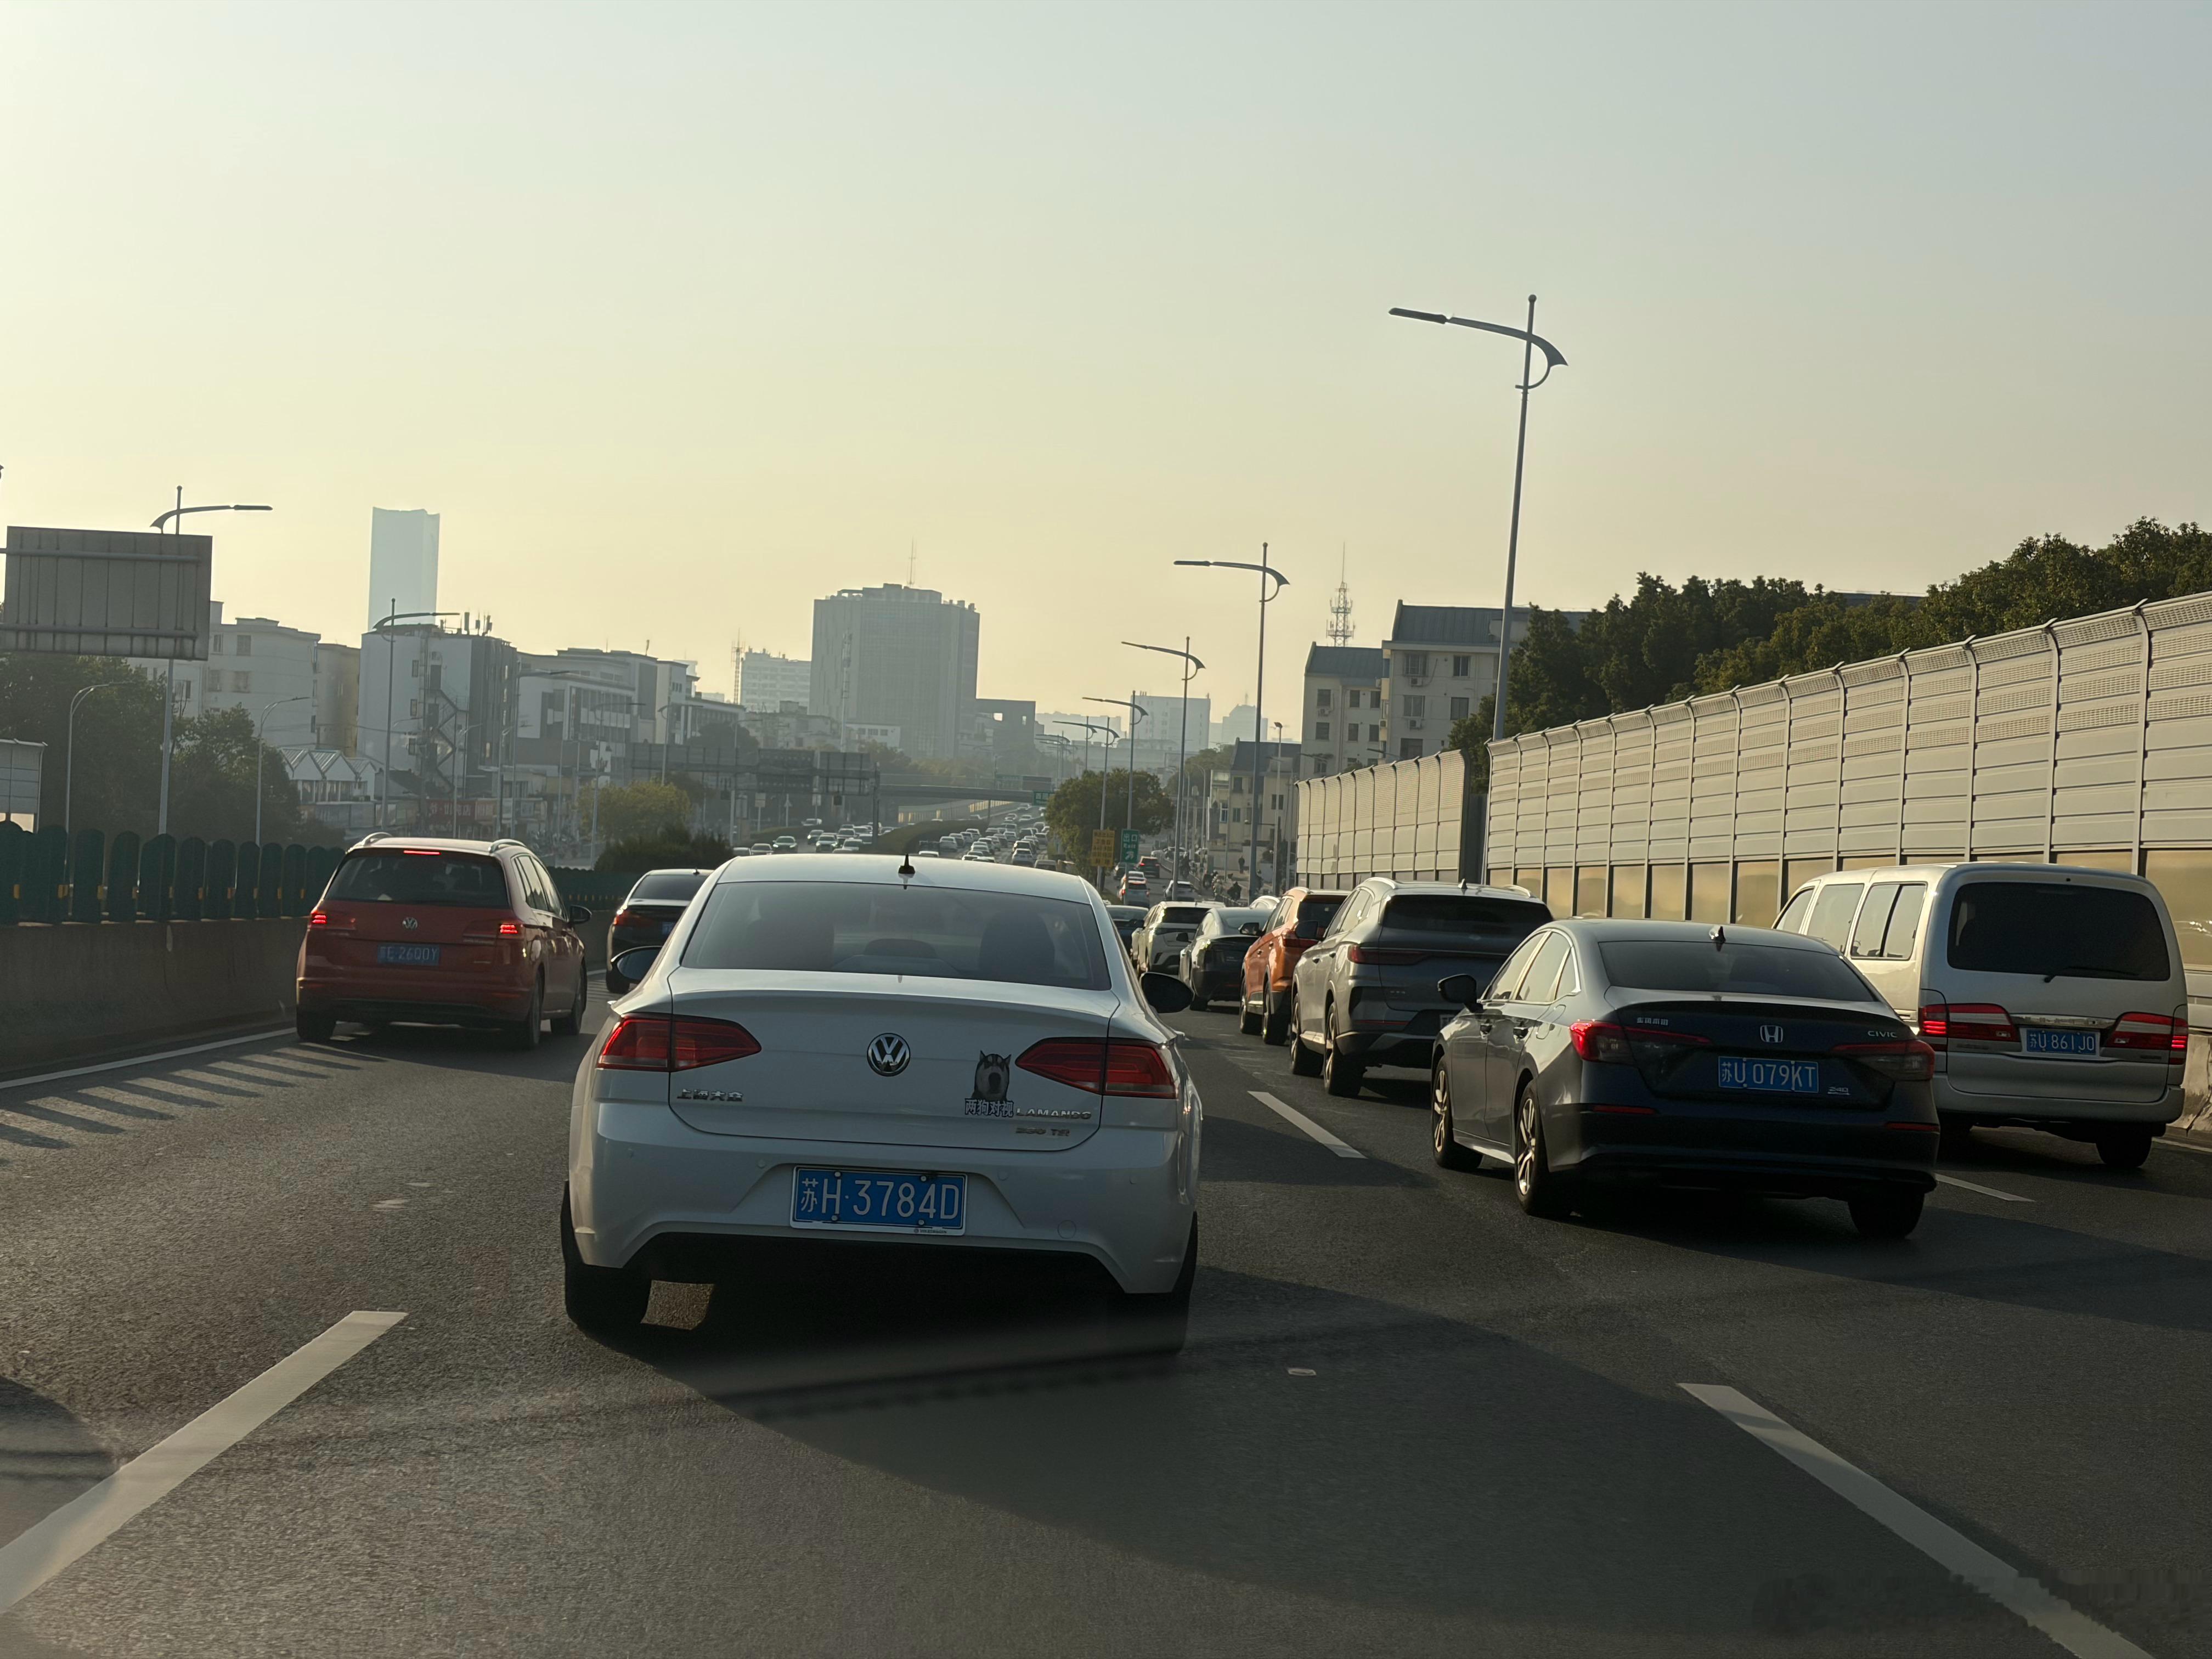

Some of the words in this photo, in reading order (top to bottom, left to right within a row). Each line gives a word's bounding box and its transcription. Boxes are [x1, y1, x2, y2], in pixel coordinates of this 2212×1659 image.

[1123, 833, 1137, 842] 出口
[676, 1088, 743, 1102] 上海大众
[965, 1098, 1014, 1118] 两狗对视
[1016, 1108, 1092, 1120] LAMANDO
